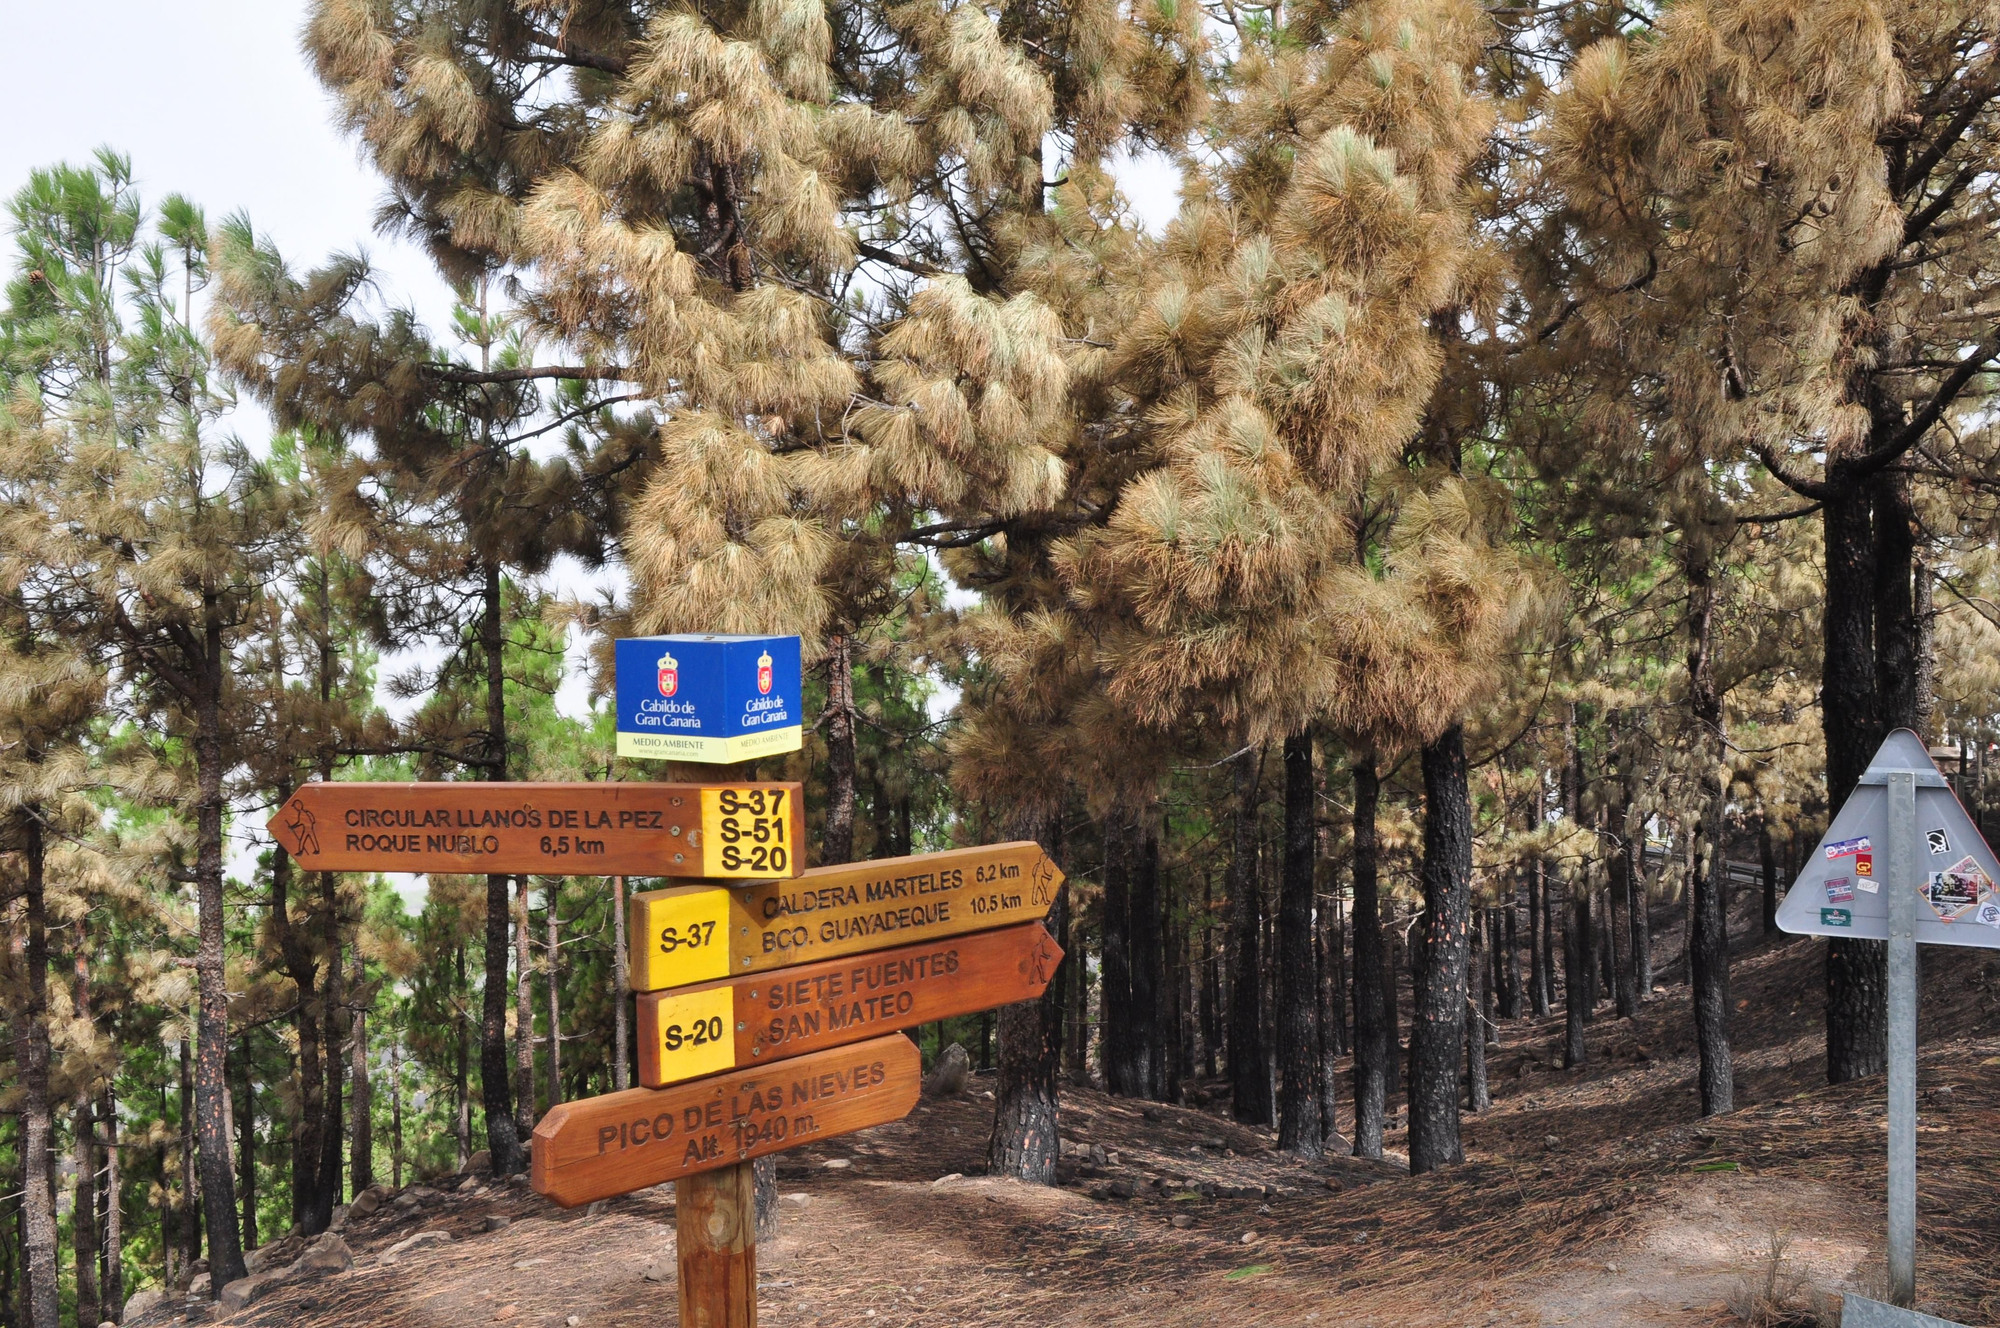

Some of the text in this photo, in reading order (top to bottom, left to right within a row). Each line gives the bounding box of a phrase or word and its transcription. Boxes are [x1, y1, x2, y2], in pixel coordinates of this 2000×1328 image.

[641, 699, 695, 714] Cabildo de
[745, 695, 784, 713] Cabildo de
[635, 713, 701, 729] Gran Canaria
[741, 709, 787, 727] Gran Canaria
[632, 738, 704, 750] MEDIO AMBIENTE
[740, 731, 789, 748] MEDIO AMBIENTE
[638, 748, 699, 758] www.grancanaria.com
[719, 789, 785, 816] S-37
[344, 809, 450, 828] CIRCULAR
[549, 810, 577, 829] DE
[584, 810, 613, 829] LA
[619, 810, 663, 829] PEZ
[720, 817, 784, 843] S-51
[346, 834, 605, 857] ROQUE NUBLO 6,5 km
[721, 845, 787, 872] S-20
[762, 863, 1020, 920] CALDERA MARTELES 6,2 km
[761, 893, 1022, 953] BCO. GUAYADEQUE 10,5 km
[660, 920, 716, 953] S-37
[767, 950, 960, 1010] SIETE FUENTES
[768, 990, 914, 1046] SAN MATEO
[665, 1016, 723, 1051] S-20
[599, 1061, 886, 1155] PICO DE LAS NIEVES
[682, 1112, 820, 1167] Alt. 1940 m.
